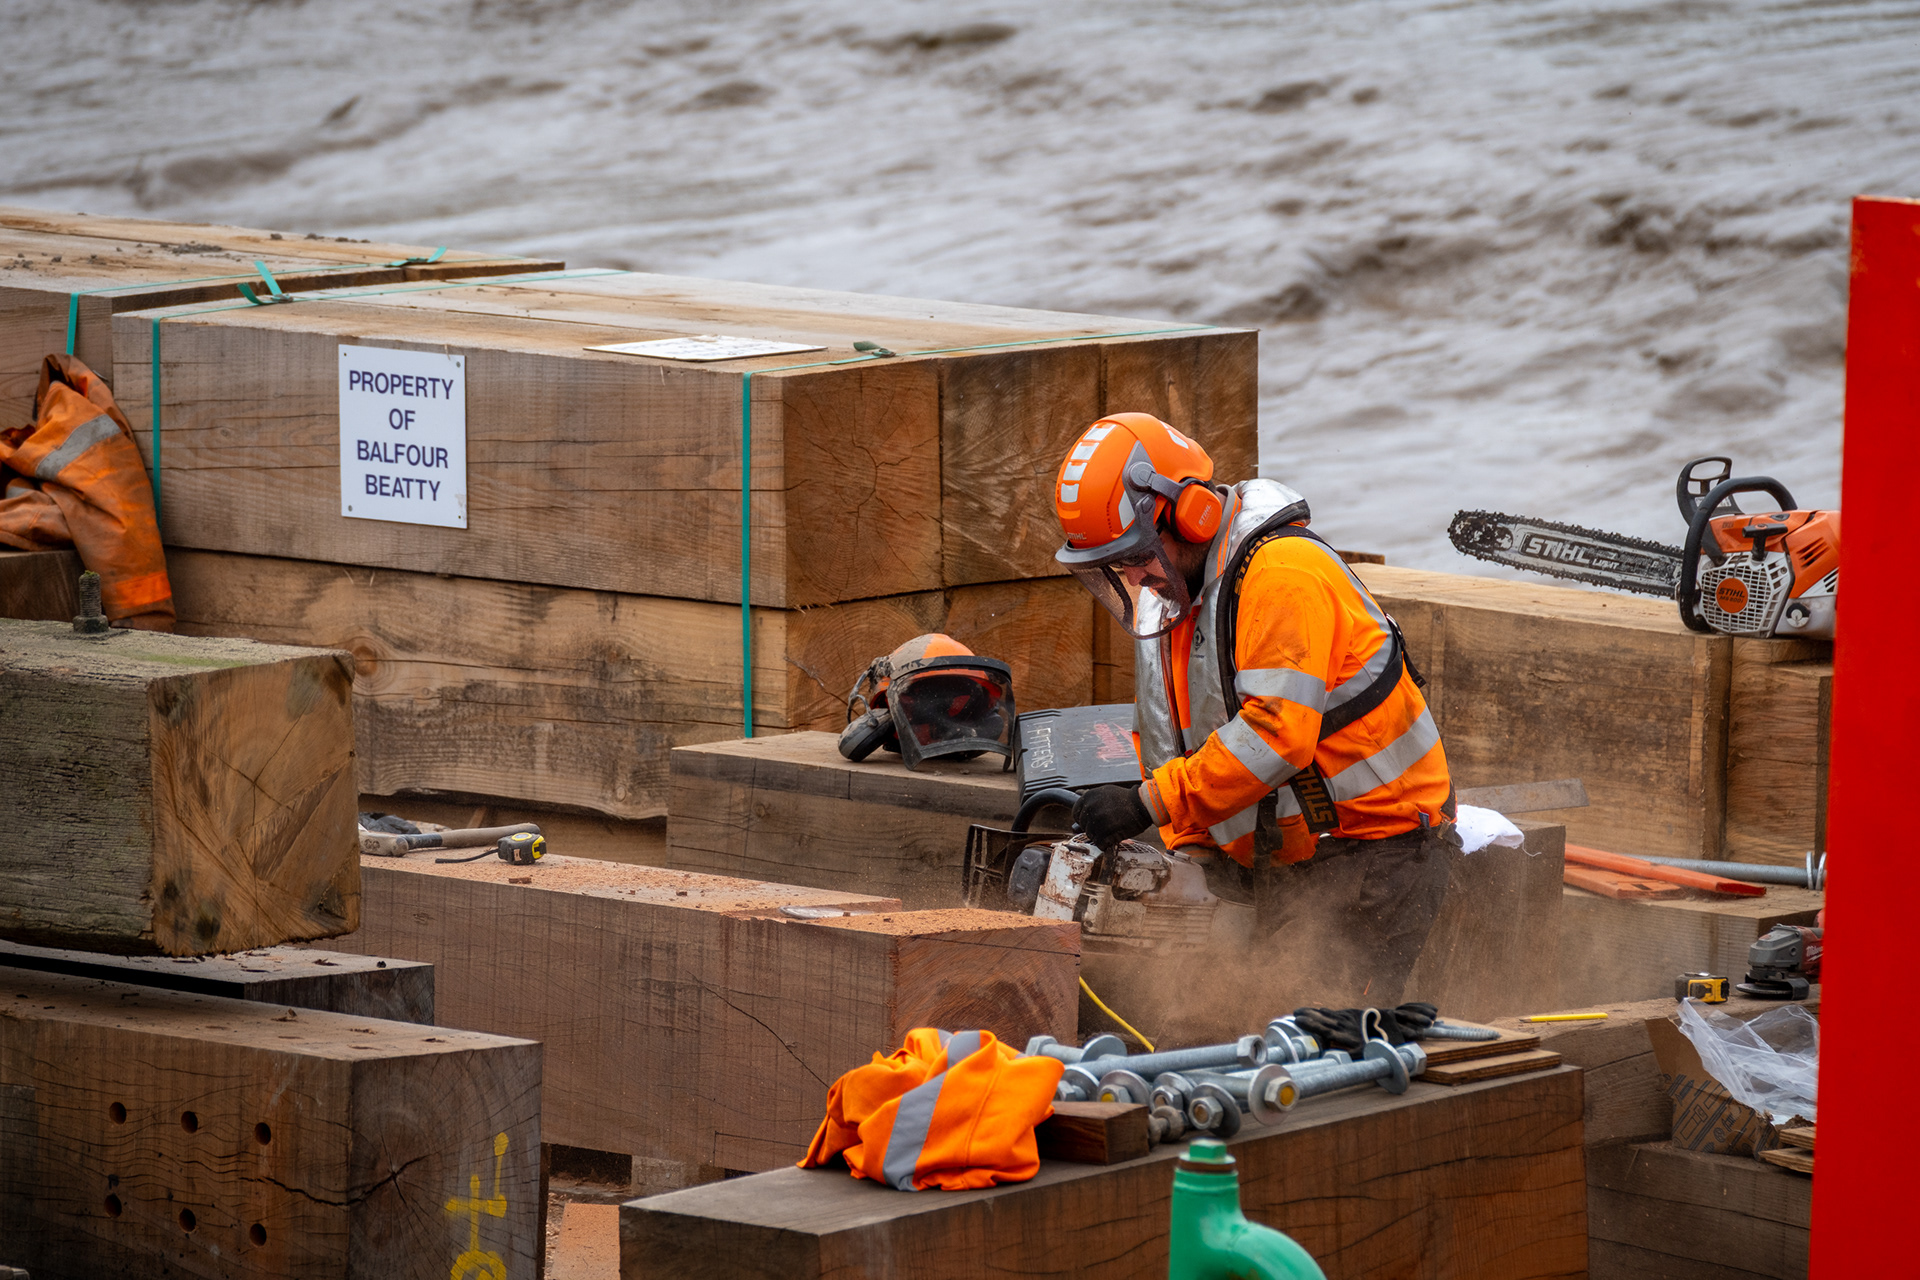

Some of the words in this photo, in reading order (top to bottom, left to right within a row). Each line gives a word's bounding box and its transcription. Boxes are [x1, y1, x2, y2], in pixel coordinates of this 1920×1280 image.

[349, 370, 454, 400] PROPERTY
[389, 408, 416, 430] OF
[357, 439, 449, 469] BALFOUR
[365, 474, 441, 501] BEATTY
[1198, 504, 1212, 526] STIHL
[1525, 537, 1592, 564] STIHL
[1718, 586, 1746, 599] STIHL
[1295, 764, 1334, 823] STIHL
